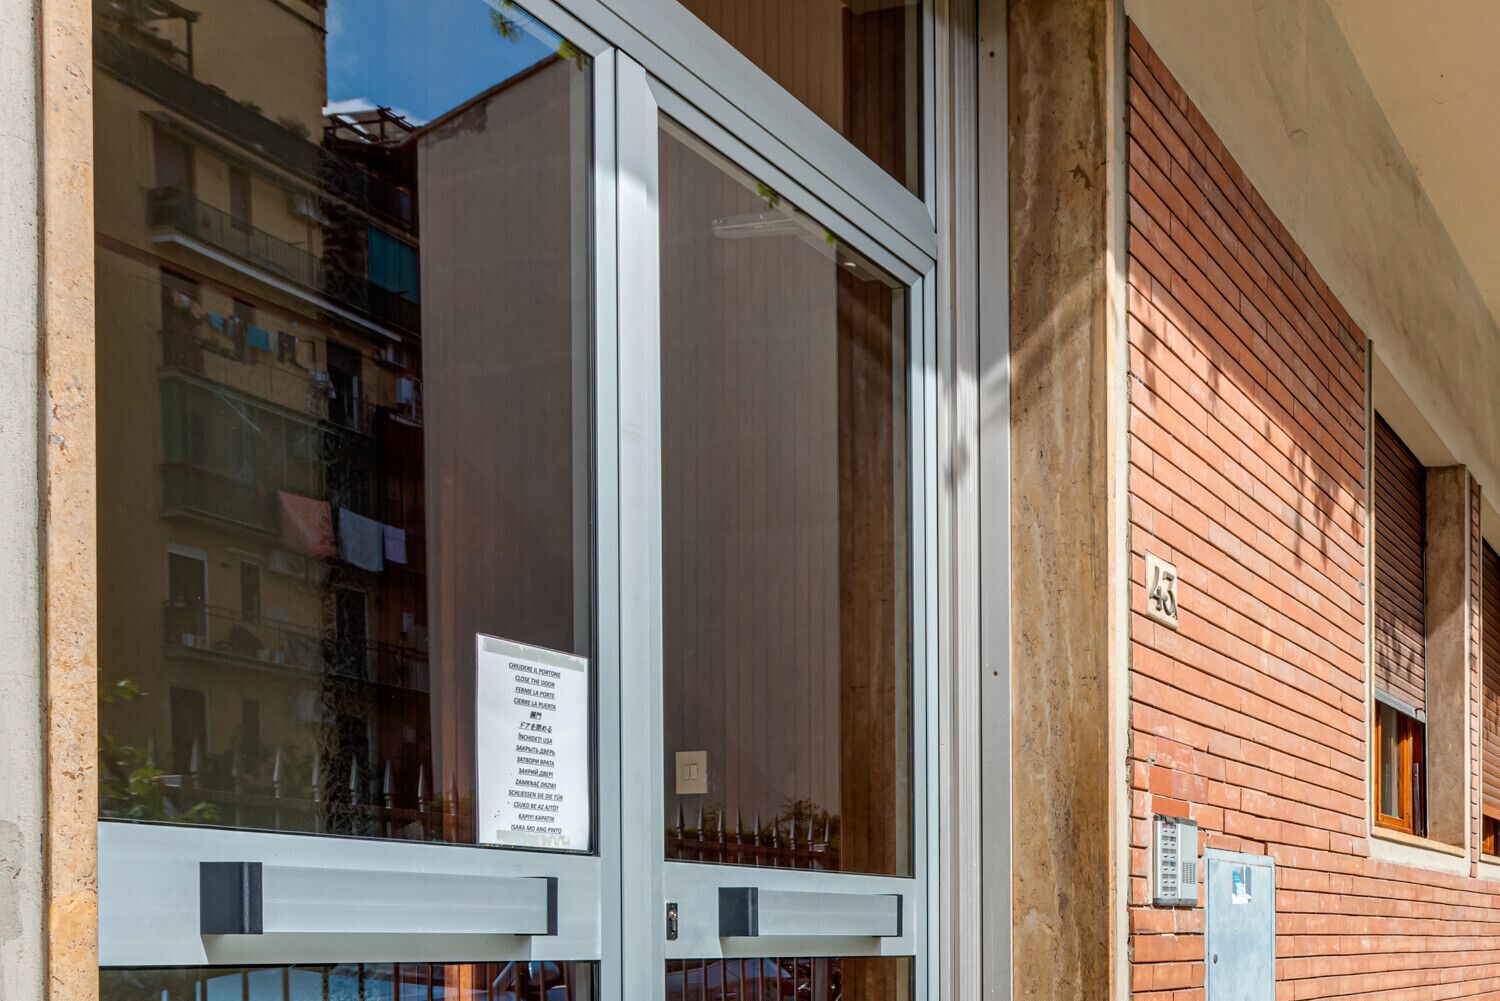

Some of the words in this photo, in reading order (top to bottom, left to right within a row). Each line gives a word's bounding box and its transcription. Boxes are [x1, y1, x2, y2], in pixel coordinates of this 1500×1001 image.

[508, 662, 533, 673] CHIUDERE
[539, 668, 561, 678] PORTONE
[515, 675, 530, 684] CLOSE
[515, 686, 532, 695] FERME
[540, 691, 555, 700] PORTE
[514, 698, 530, 706] CIERRE
[538, 702, 556, 711] PUERTA
[508, 789, 536, 798] SCHLIESSEN
